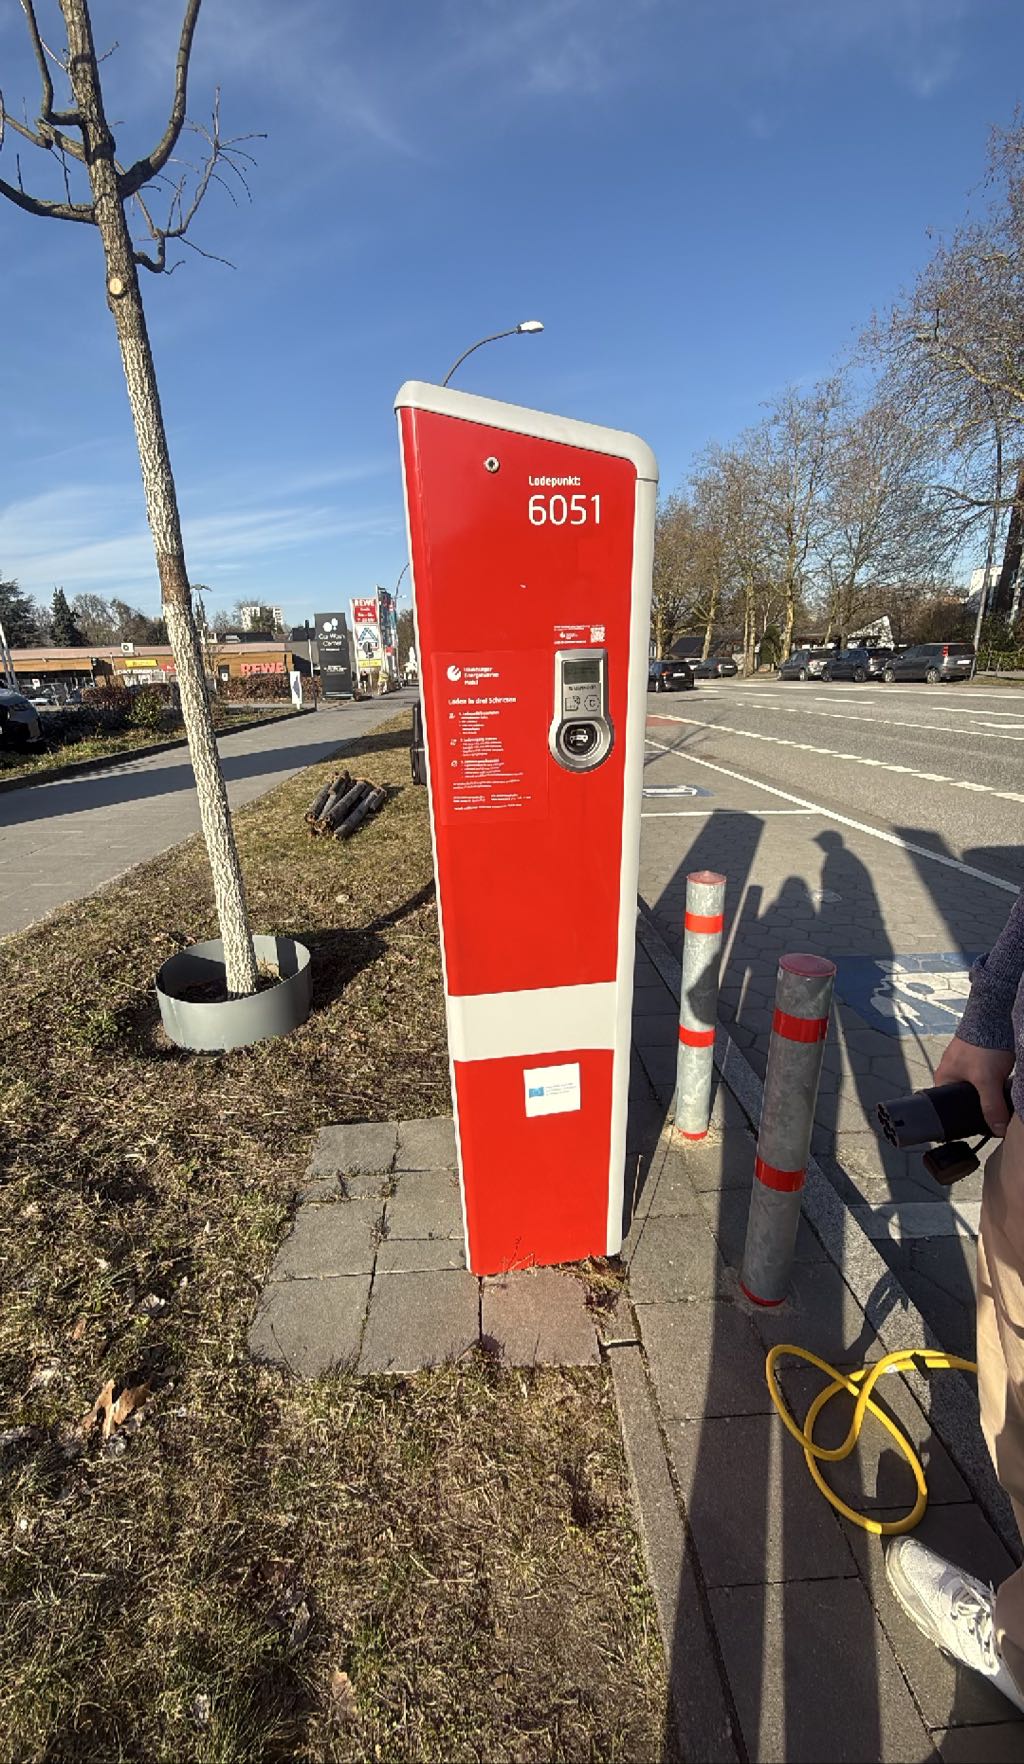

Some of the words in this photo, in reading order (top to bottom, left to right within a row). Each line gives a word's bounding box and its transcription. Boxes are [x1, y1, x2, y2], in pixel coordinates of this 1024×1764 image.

[528, 475, 581, 488] Ladepunkt:
[528, 494, 600, 526] 6051
[354, 599, 375, 607] REWE
[240, 662, 285, 676] REWE
